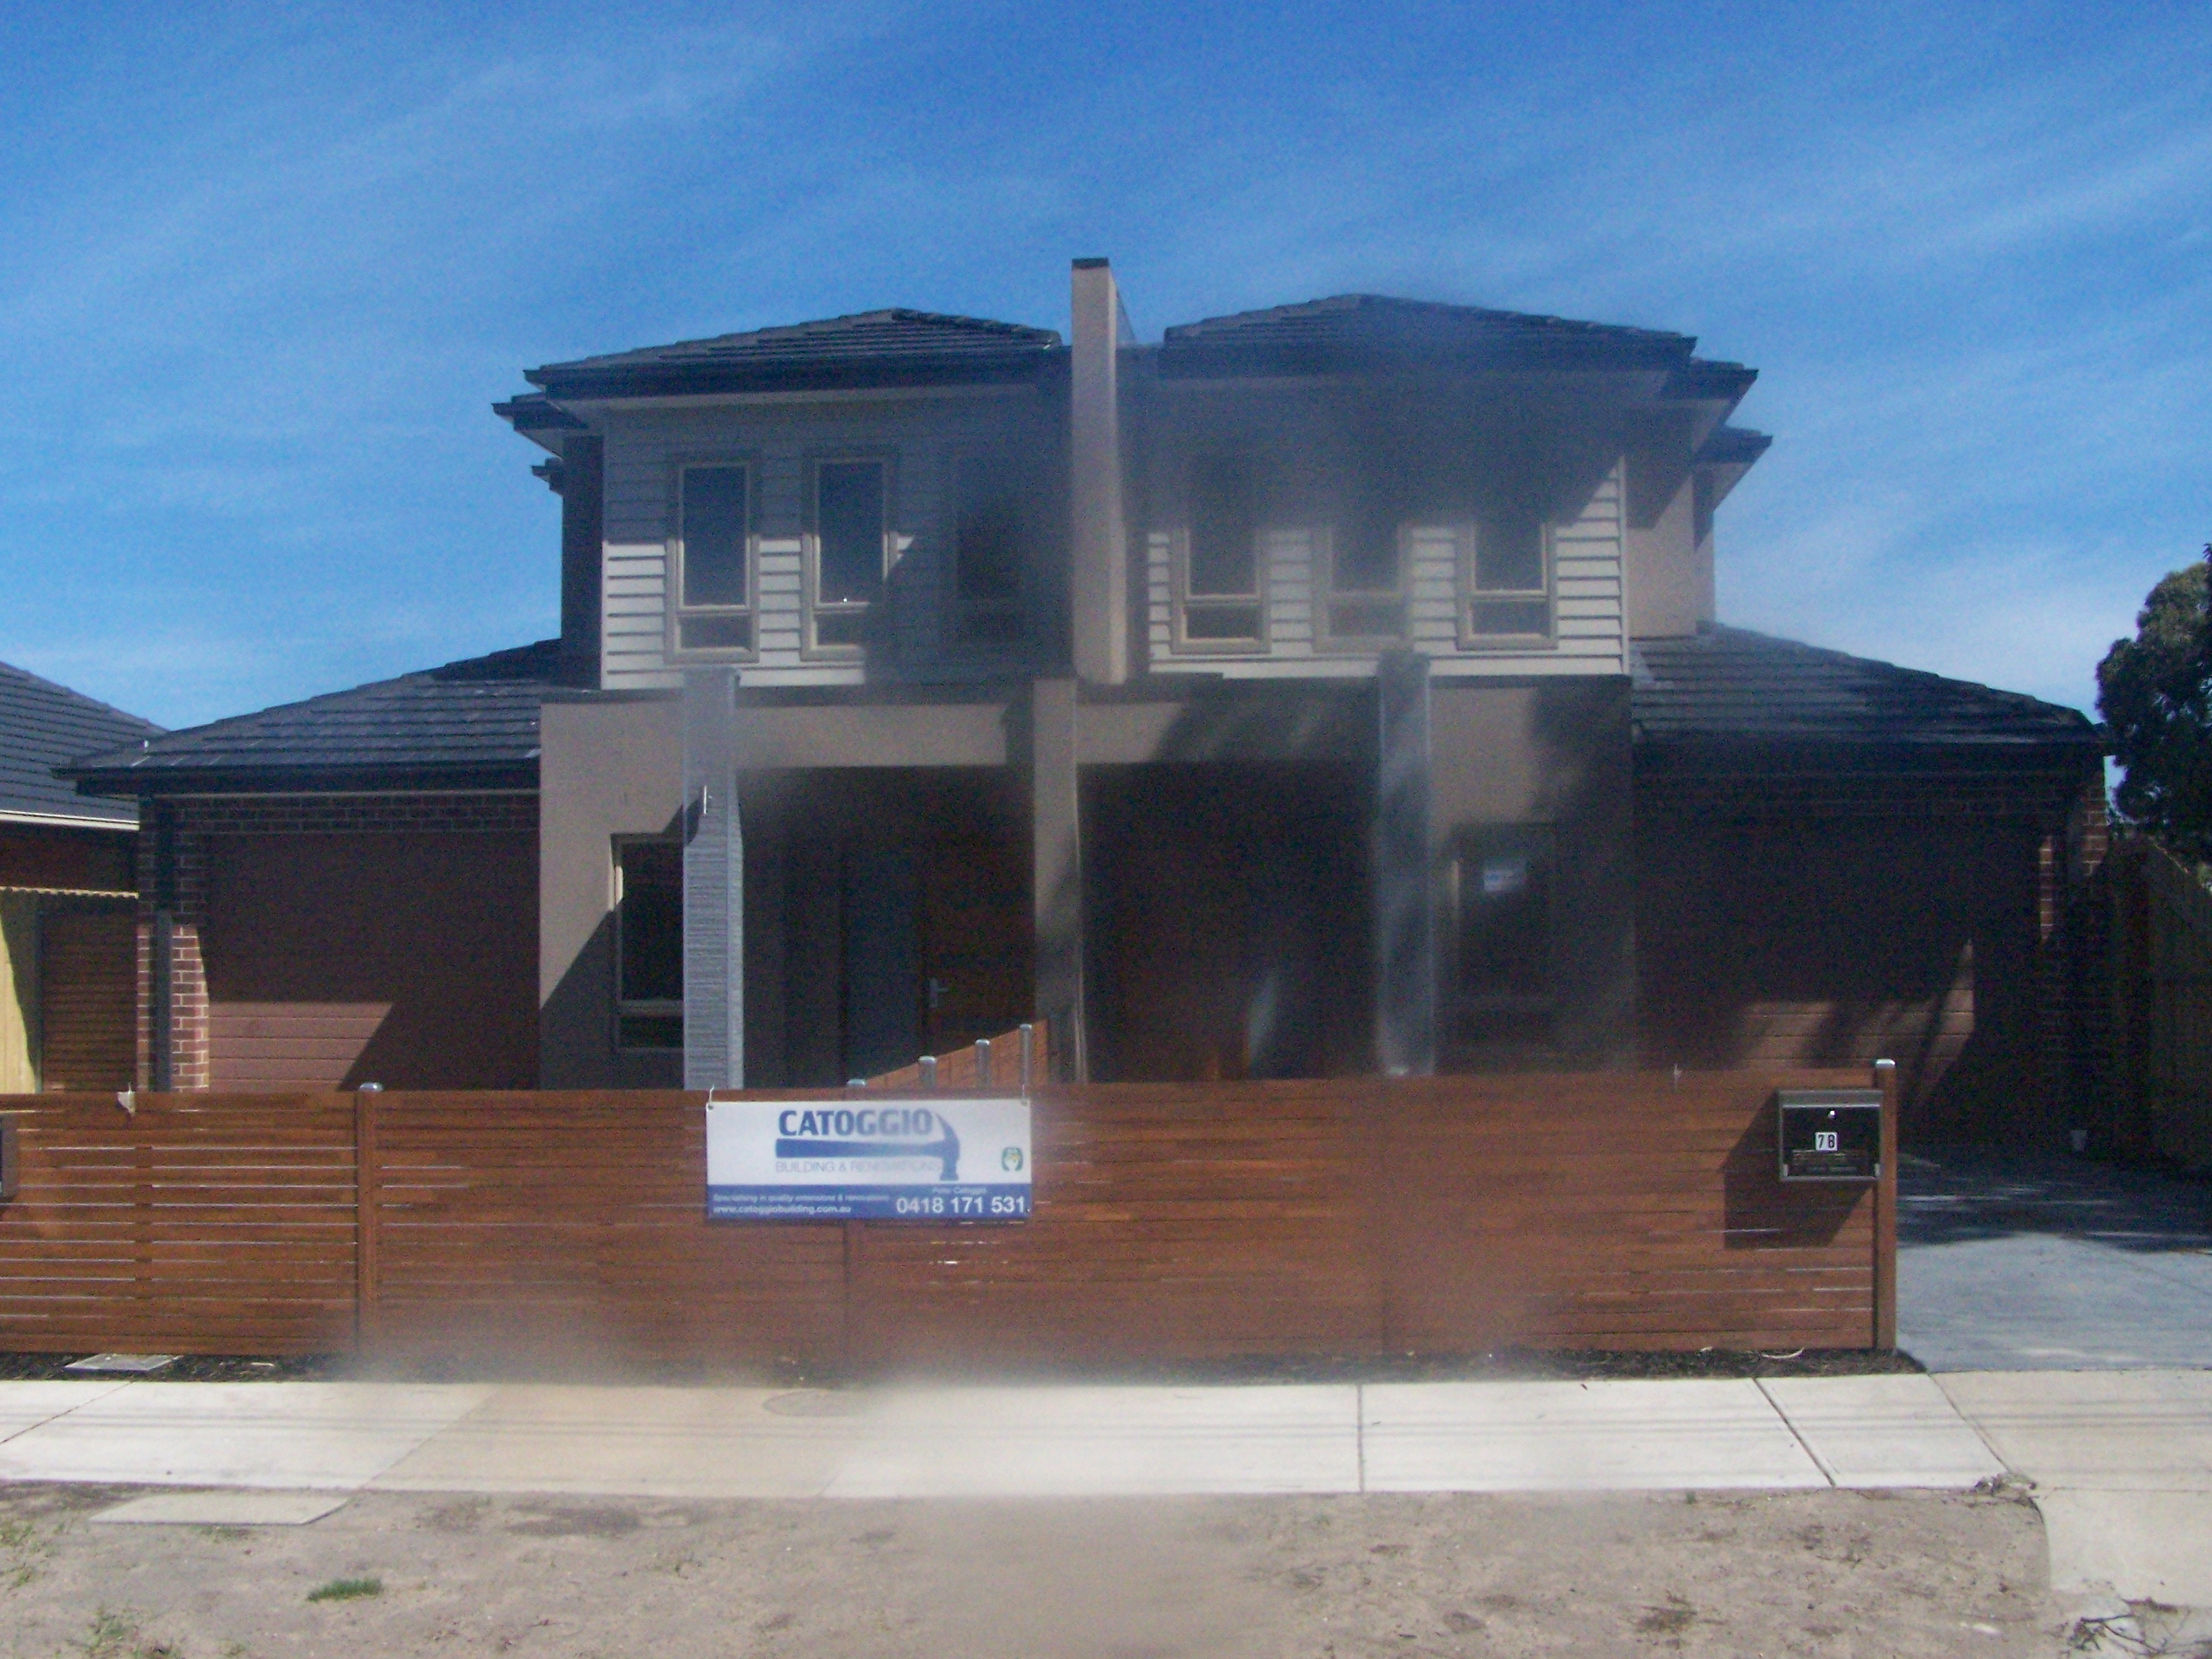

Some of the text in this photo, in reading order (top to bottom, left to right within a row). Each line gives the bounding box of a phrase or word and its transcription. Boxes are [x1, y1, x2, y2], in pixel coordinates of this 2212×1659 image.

[778, 1109, 933, 1136] CATOGGIO
[775, 1161, 835, 1173] BUILDING
[839, 1161, 847, 1173] &
[896, 1195, 1024, 1213] 0418 171 531
